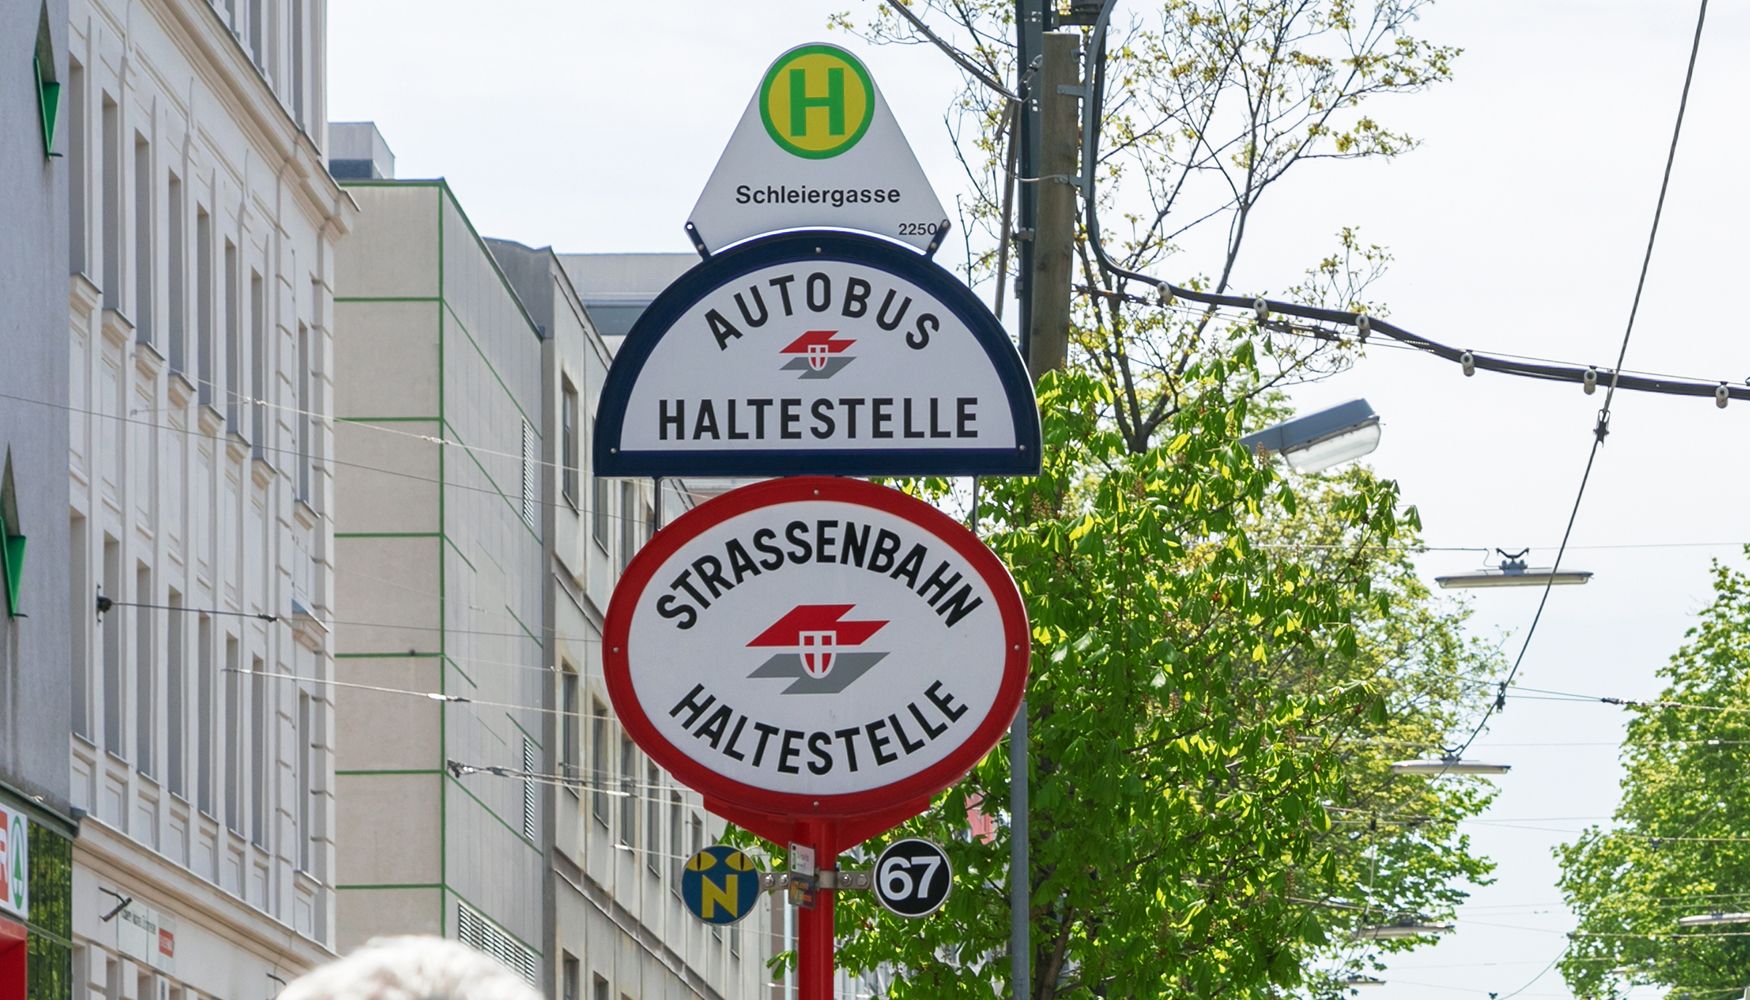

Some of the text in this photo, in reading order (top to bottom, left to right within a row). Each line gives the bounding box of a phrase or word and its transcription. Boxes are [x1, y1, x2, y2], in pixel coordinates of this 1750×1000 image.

[788, 67, 846, 137] H
[735, 184, 901, 208] Schleiergasse
[898, 222, 938, 236] 2250
[703, 271, 941, 352] AUTOBUS
[658, 397, 979, 441] HALTESTELLE
[656, 519, 984, 631] STRASSENBAHN
[669, 679, 969, 775] HALTESTELLE
[701, 874, 737, 919] N
[879, 855, 942, 901] 67
